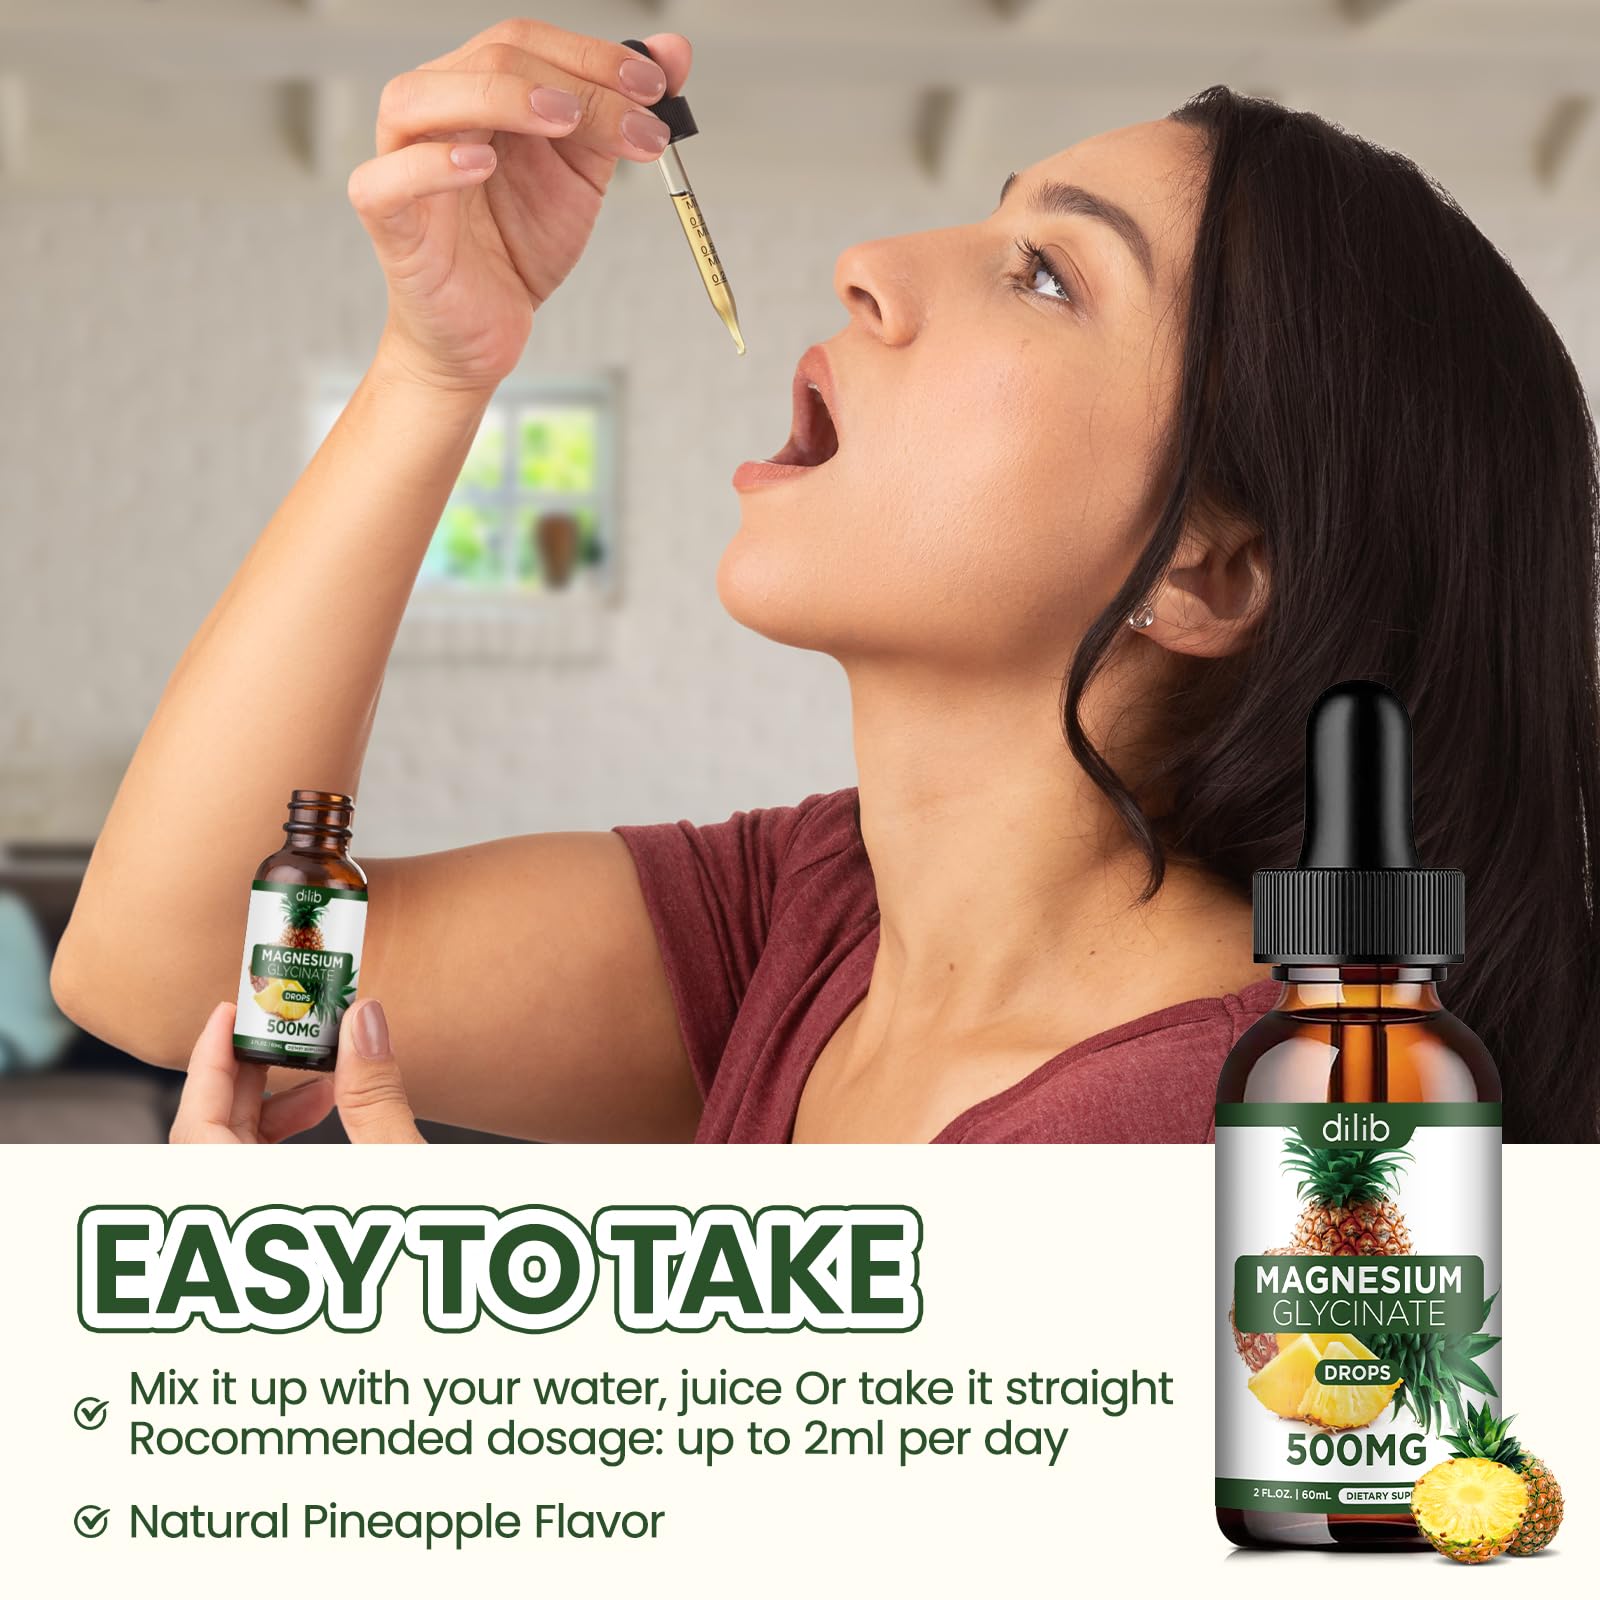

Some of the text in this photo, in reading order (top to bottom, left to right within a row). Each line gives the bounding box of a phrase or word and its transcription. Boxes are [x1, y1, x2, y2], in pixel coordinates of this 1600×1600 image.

[296, 889, 322, 904] dilib
[261, 949, 344, 969] MAGNESIUM
[267, 963, 335, 982] GLYCINATE
[285, 992, 311, 1002] DROPS
[266, 1019, 320, 1038] 500MG
[1322, 1113, 1390, 1143] dilib
[1256, 1265, 1462, 1294] MAGNESIUM
[1272, 1299, 1446, 1327] GLYCINATE
[1324, 1365, 1391, 1381] DROPS
[1286, 1432, 1428, 1467] 500MG
[1253, 1488, 1260, 1497] 2
[1261, 1488, 1293, 1499] FL.OZ.
[1301, 1489, 1332, 1500] 60mL
[1346, 1491, 1389, 1501] DIETARY
